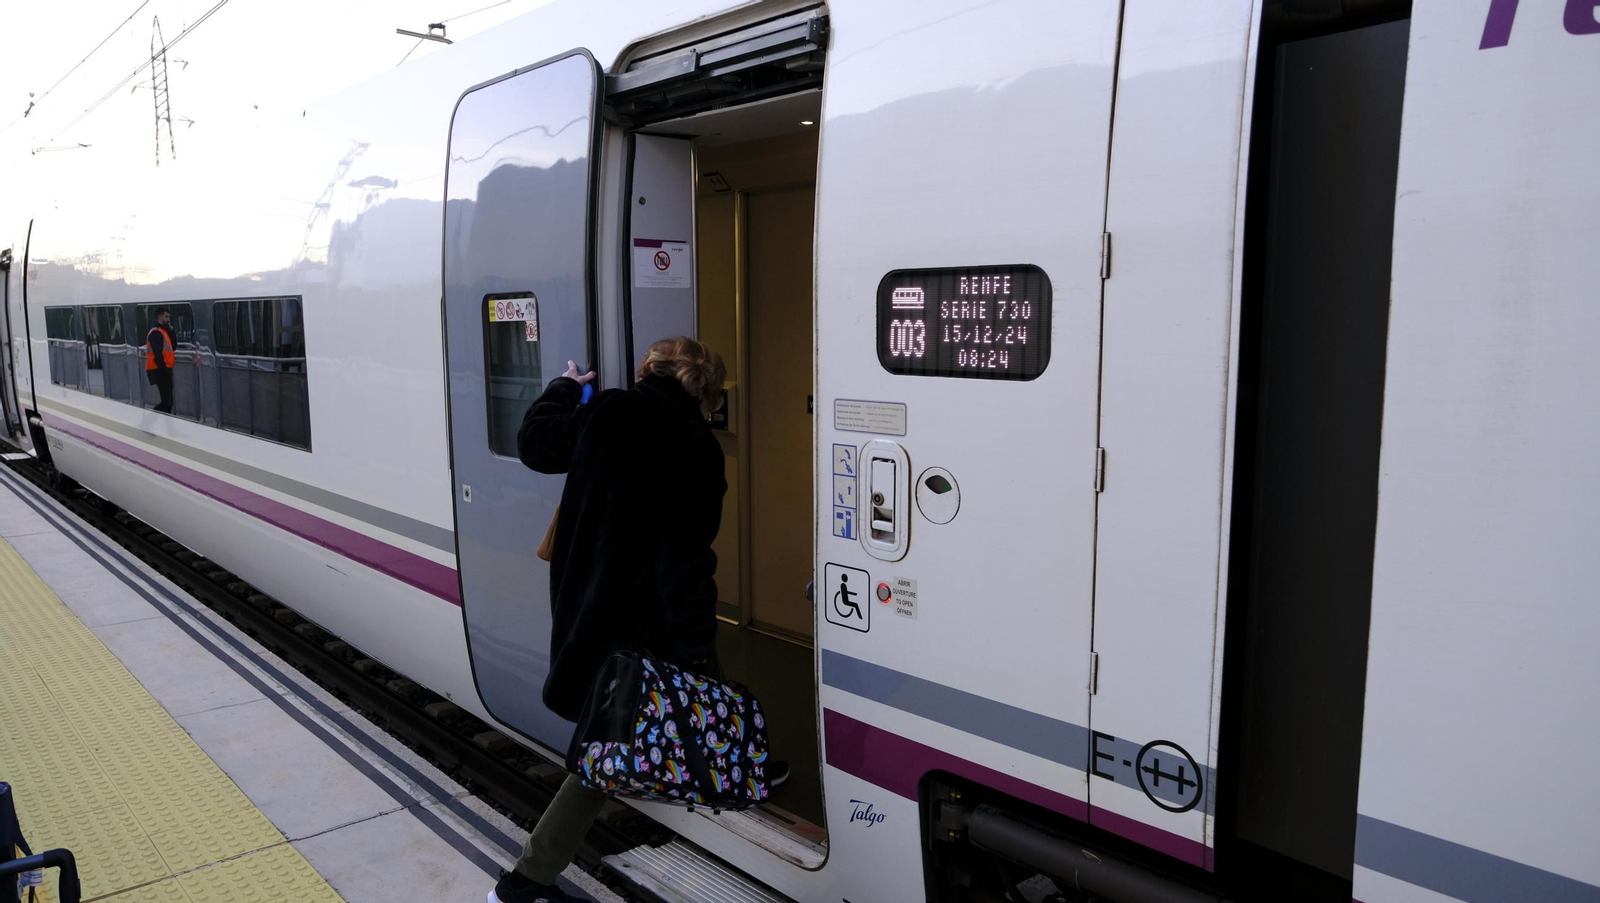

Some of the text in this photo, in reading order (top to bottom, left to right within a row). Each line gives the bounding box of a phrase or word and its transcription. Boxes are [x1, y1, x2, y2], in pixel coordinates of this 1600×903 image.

[960, 275, 1011, 295] RENFE
[940, 300, 1032, 319] SERIE 730
[889, 319, 926, 358] 003
[942, 324, 1028, 345] 15/12/24
[958, 349, 1009, 369] 08:24
[892, 588, 916, 598] OUVERTURE
[849, 799, 887, 828] Talgo
